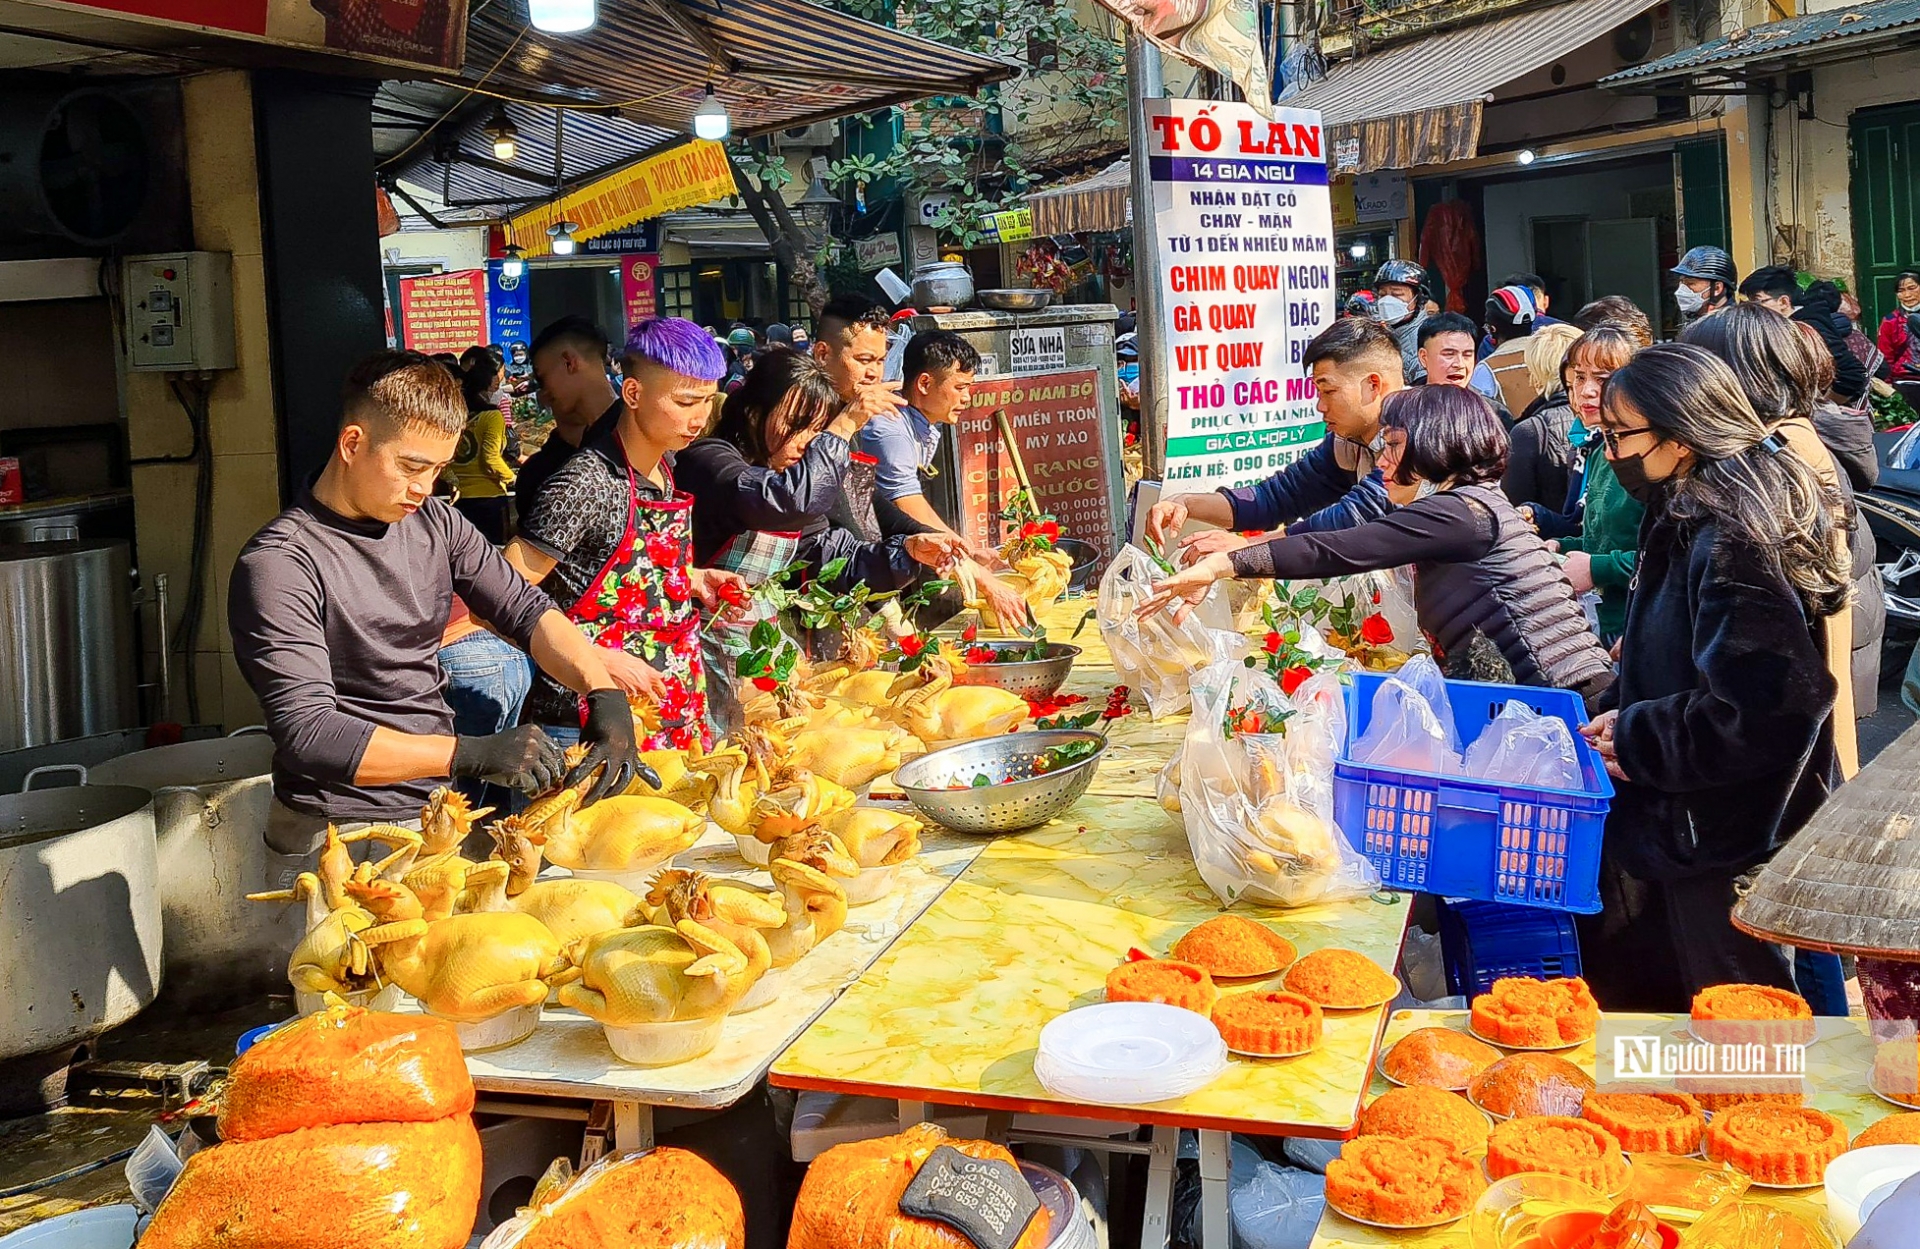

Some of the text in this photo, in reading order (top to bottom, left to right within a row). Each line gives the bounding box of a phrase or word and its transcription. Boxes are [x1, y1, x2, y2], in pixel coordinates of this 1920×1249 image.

[1152, 106, 1222, 152] TỐ
[1237, 120, 1320, 158] LAN
[1192, 163, 1295, 180] 14 GIA NGƯ
[1190, 189, 1236, 208] NHẬN
[1242, 190, 1271, 209] ĐẶT
[1200, 214, 1242, 228] CHAY
[1259, 212, 1292, 231] MẶN
[1168, 233, 1327, 252] TỪ 1 ĐẾN NHIỀU MÂM
[1170, 265, 1280, 293] CHIM QUAY
[1288, 265, 1329, 290] NGON
[1173, 301, 1257, 333] GÀ QUAY
[1289, 298, 1320, 331] ĐẶC
[1012, 330, 1035, 355] SỬA
[1039, 332, 1064, 353] NHÀ
[1175, 342, 1264, 376] VỊT QUAY
[1000, 388, 1025, 404] BÒ
[1029, 385, 1066, 402] NAM
[1070, 380, 1093, 401] BỘ
[1177, 373, 1320, 410] THỎ CÁC MÓ
[1013, 409, 1051, 428] MIẾN
[1057, 406, 1097, 425] TRỘN
[1191, 403, 1315, 431] PHỤC VỤ TẠI NHÀ
[1026, 432, 1050, 450] MỲ
[1056, 430, 1088, 446] XÀO
[1206, 426, 1305, 451] GIÁ CẢ HỢP LÝ
[1034, 457, 1099, 478] RANG
[1234, 456, 1263, 471] 090
[1268, 451, 1292, 467] 685
[1034, 477, 1100, 497] NƯỚC
[1053, 497, 1107, 512] 30.000đ
[1059, 509, 1108, 523] 0.000đ
[964, 1163, 1000, 1179] GAS
[961, 1180, 984, 1198] 652
[985, 1192, 1012, 1222] 3233
[980, 1174, 1017, 1212] THỊNH
[955, 1190, 979, 1210] 652
[979, 1205, 1005, 1235] 3223
